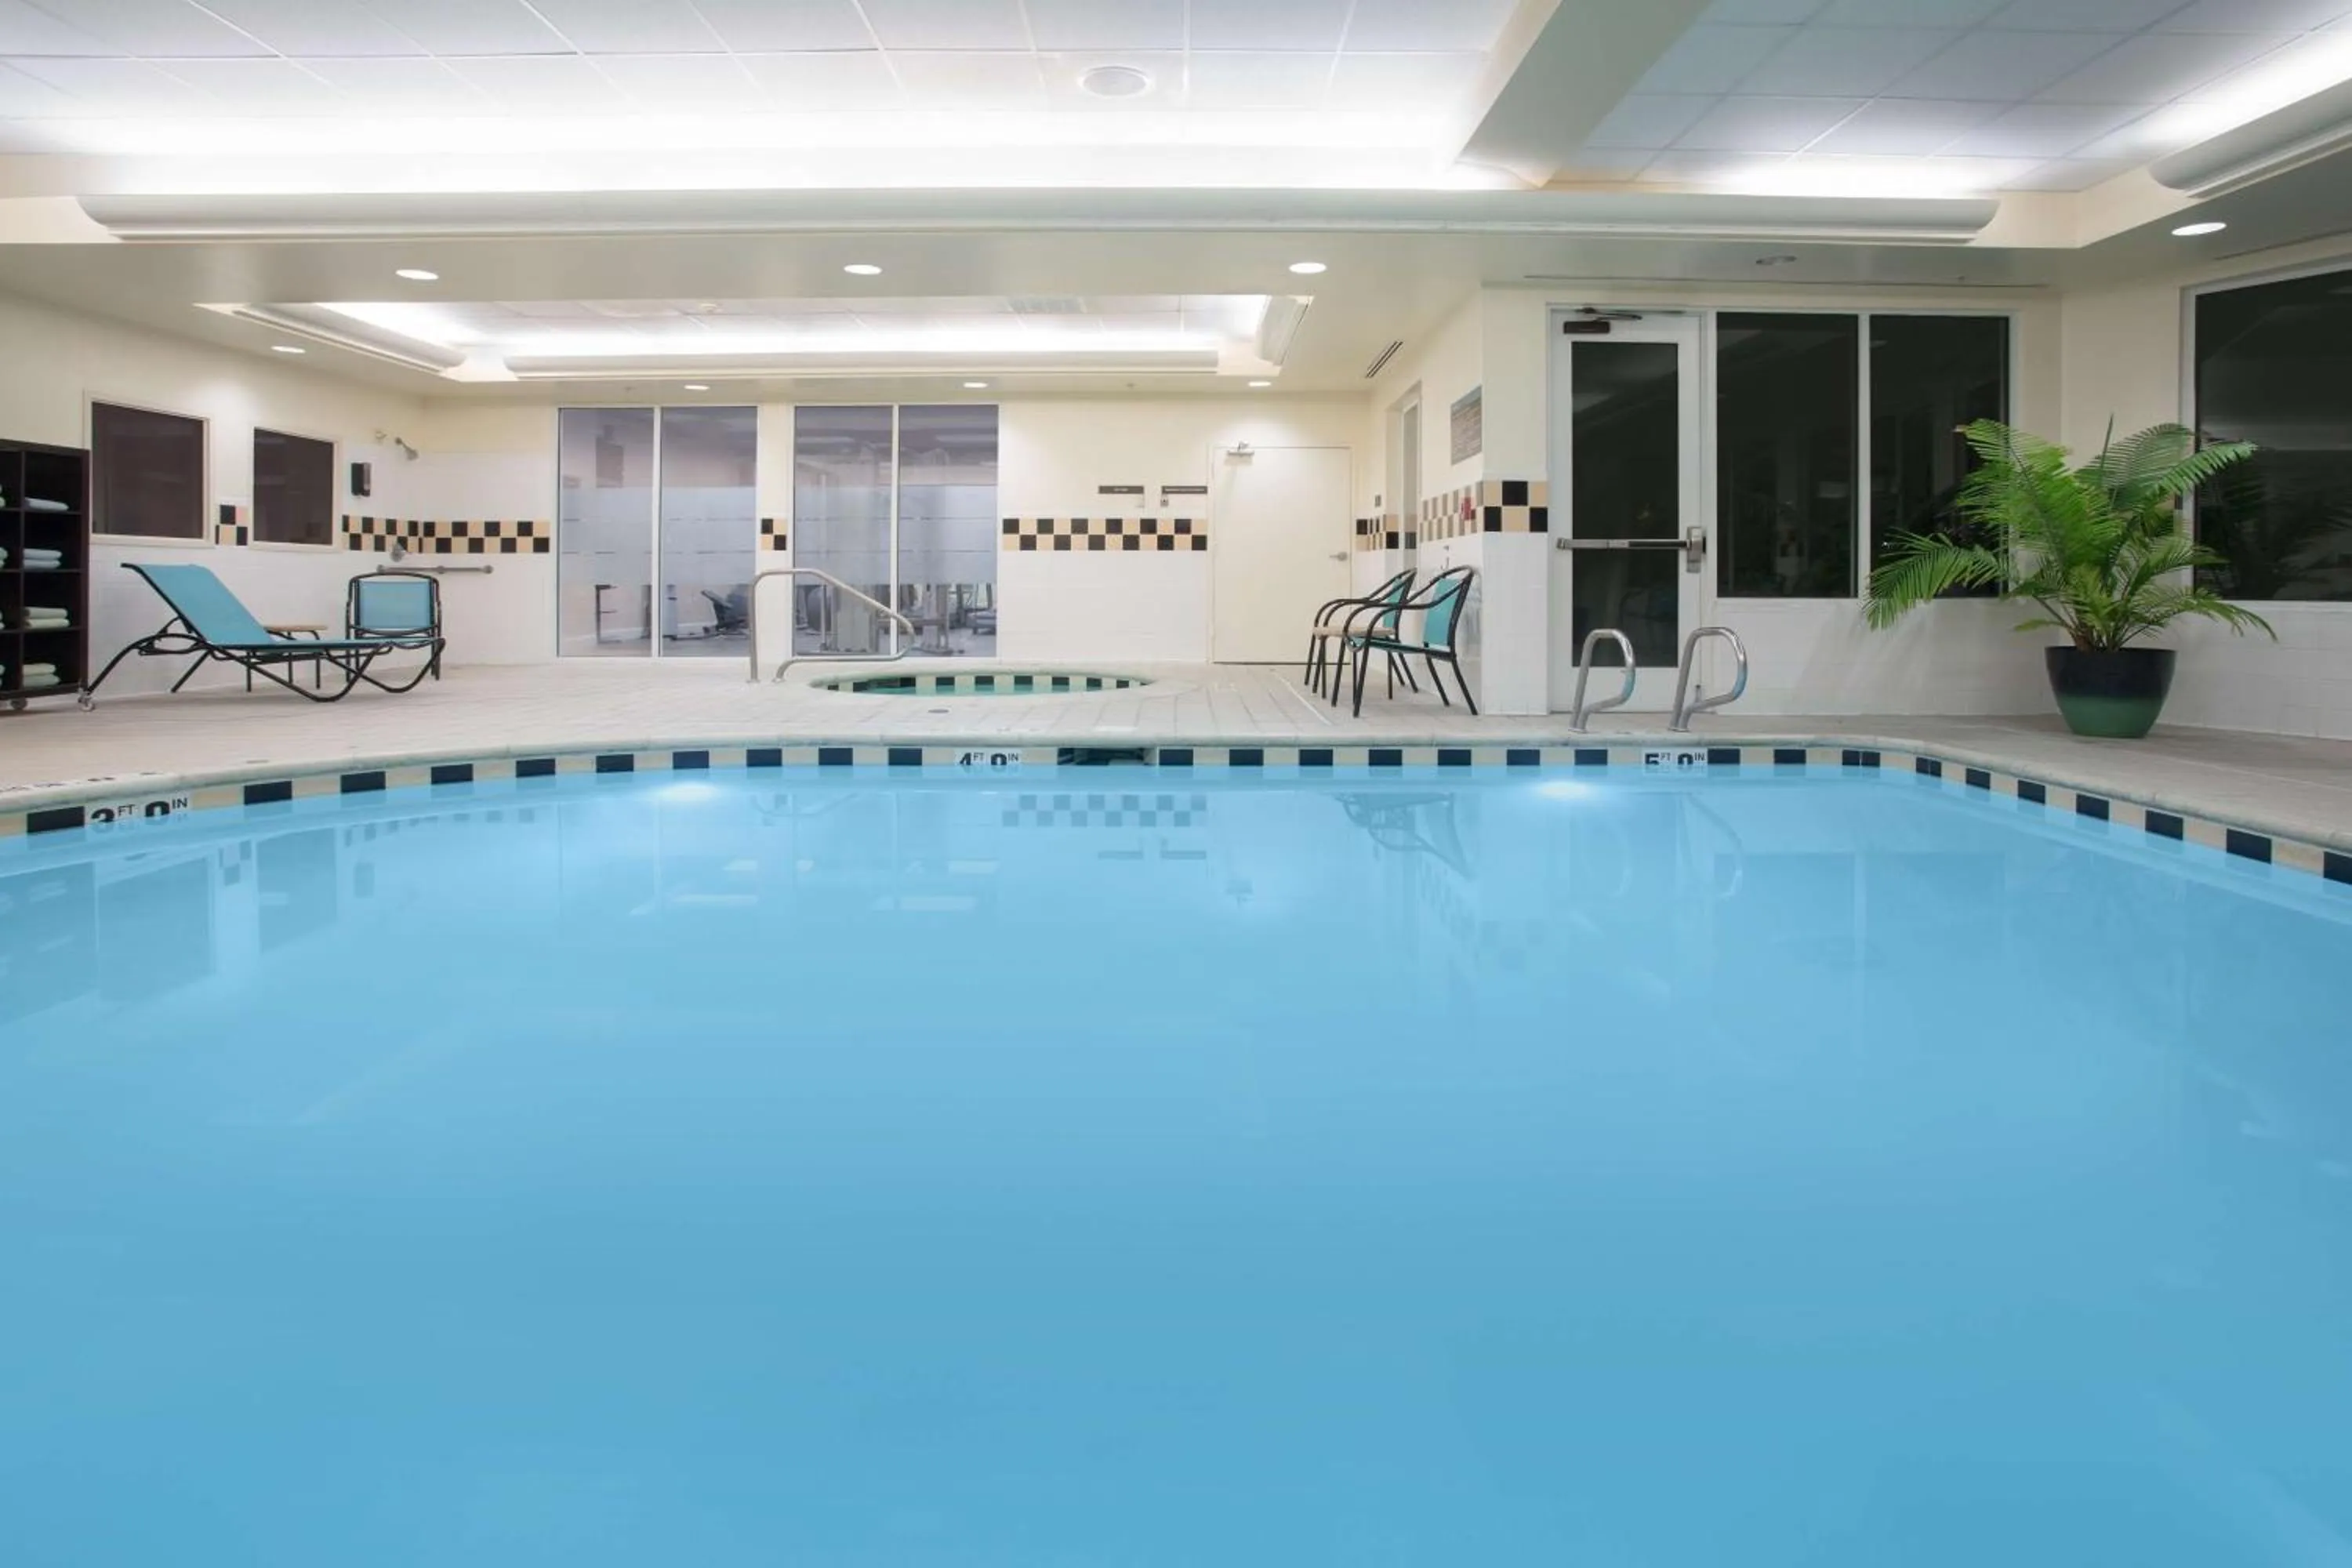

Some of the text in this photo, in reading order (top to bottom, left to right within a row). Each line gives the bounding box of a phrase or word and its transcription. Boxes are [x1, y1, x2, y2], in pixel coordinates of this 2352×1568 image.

[973, 752, 985, 761] FT
[1007, 753, 1019, 762] IN
[1661, 752, 1671, 761] FT
[1694, 752, 1706, 761] IN
[118, 804, 136, 817] FT
[172, 797, 188, 809] IN
